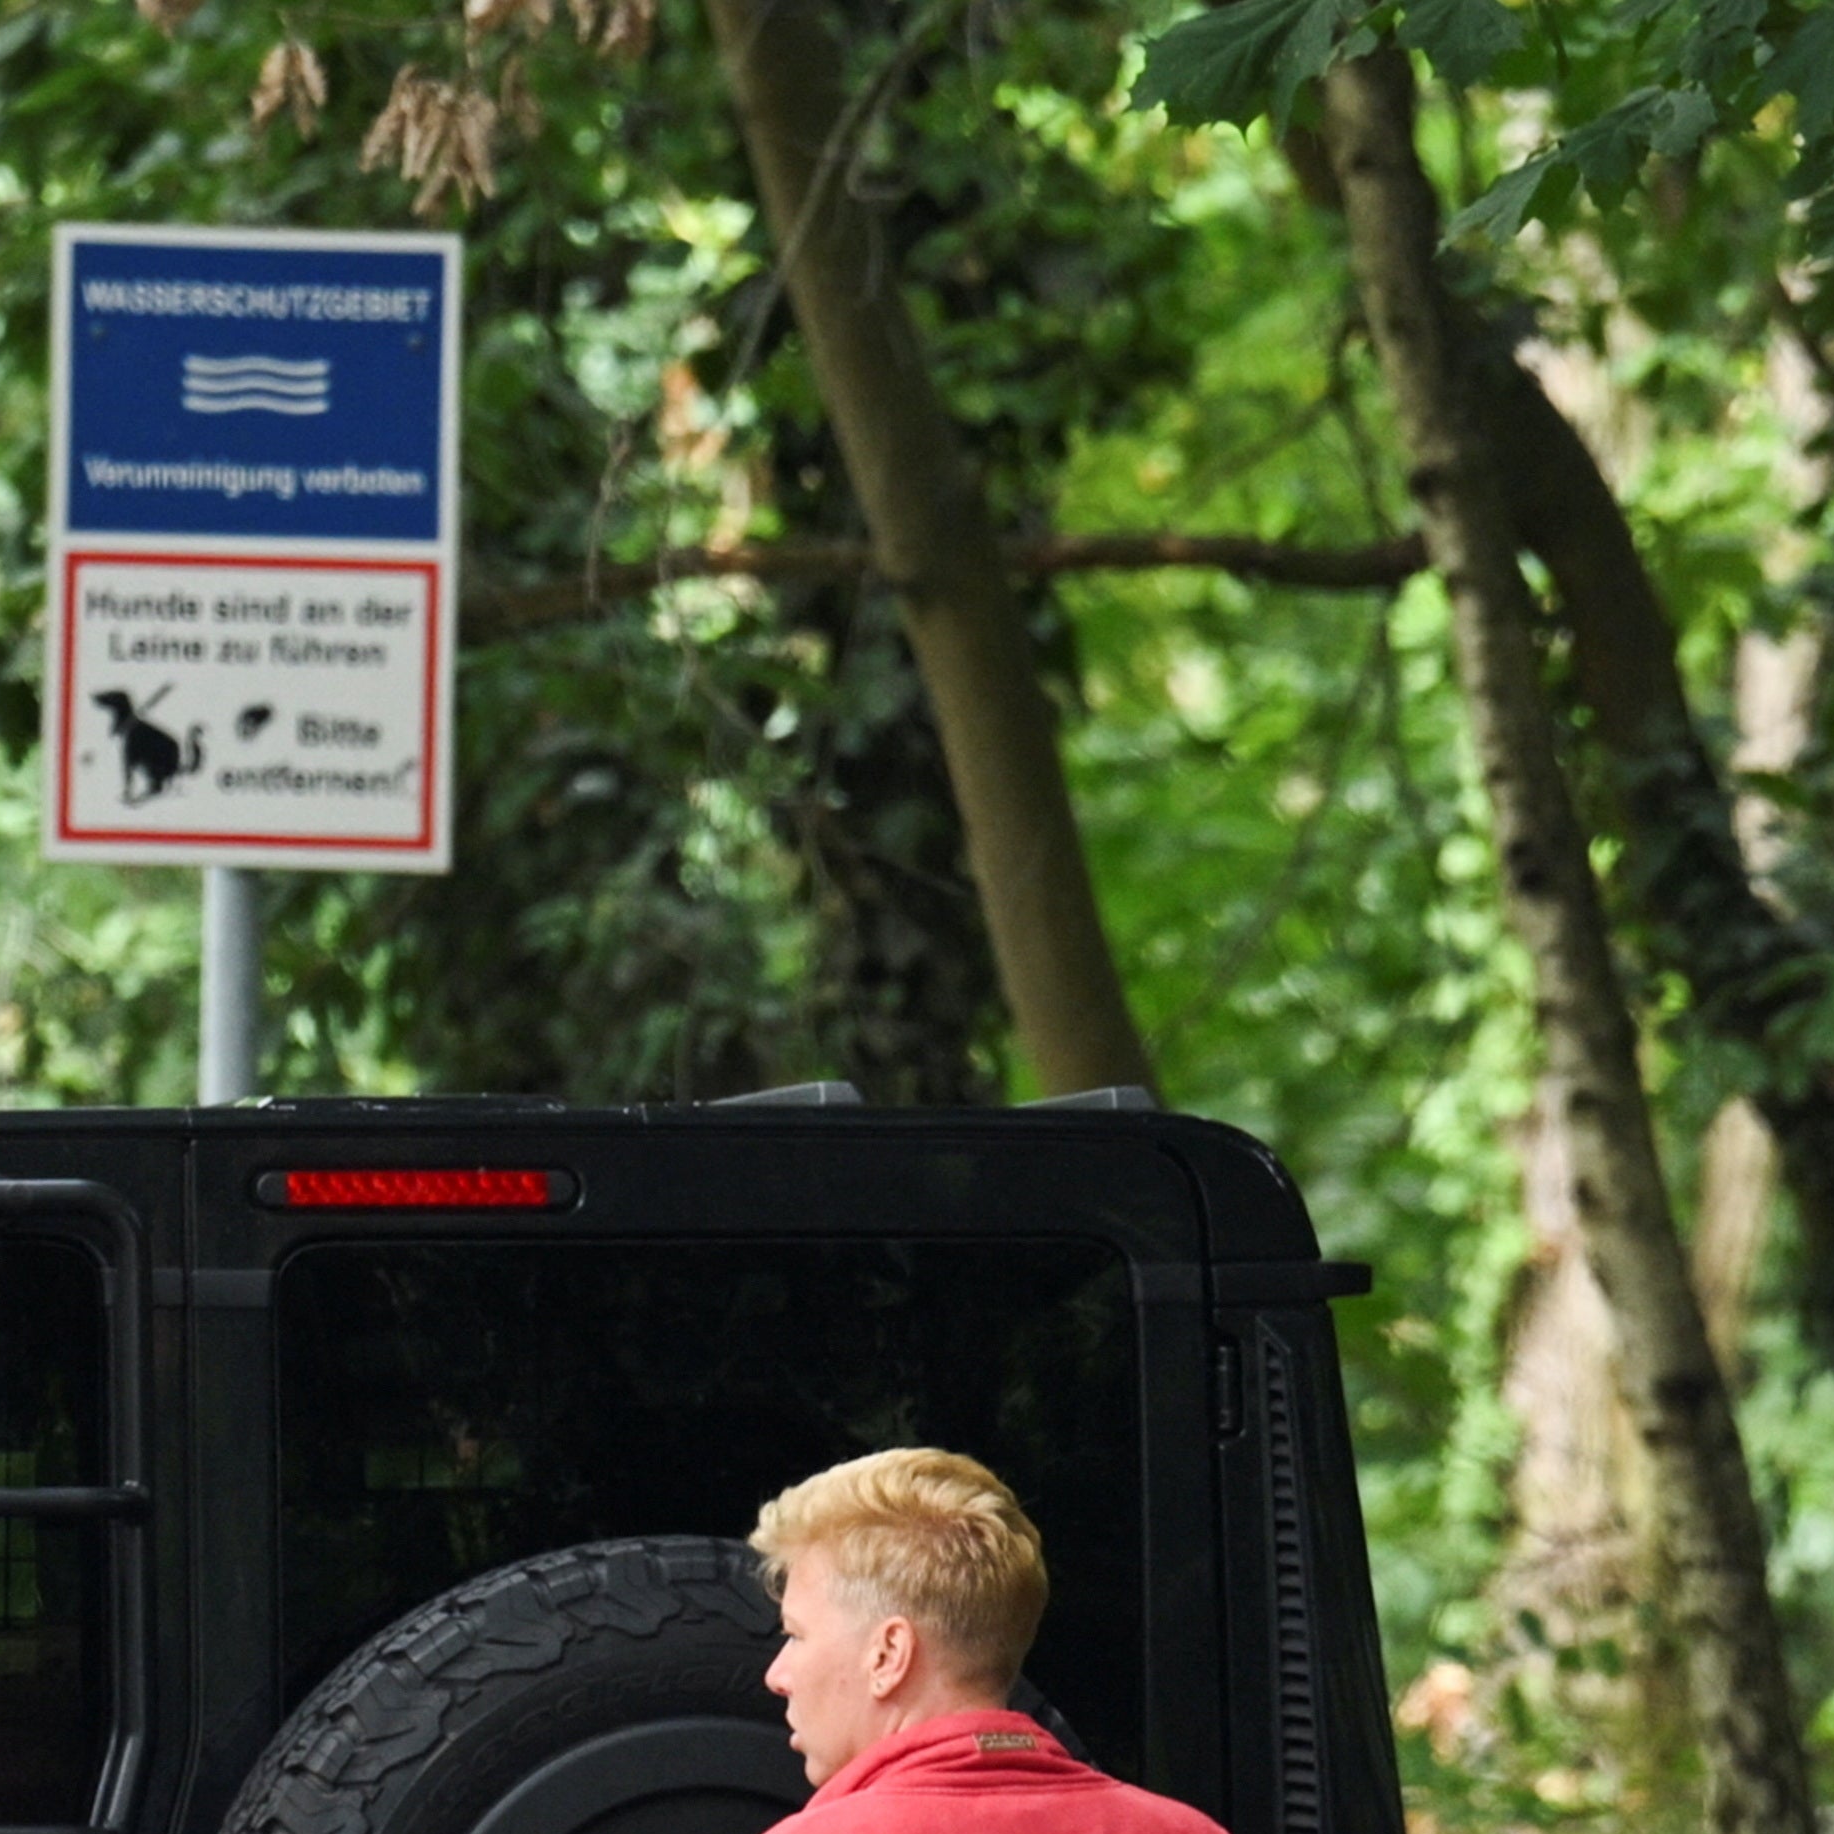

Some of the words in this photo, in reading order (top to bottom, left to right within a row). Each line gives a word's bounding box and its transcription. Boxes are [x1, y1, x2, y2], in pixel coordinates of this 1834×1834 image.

[82, 281, 430, 322] WASSERSCHUTZGEBIET
[83, 454, 297, 499] Verunreinigung
[302, 464, 426, 496] verboten
[85, 593, 200, 621] Hunde
[213, 595, 290, 623] sind
[302, 600, 342, 624] an
[356, 599, 413, 626] der
[109, 631, 203, 662] Leine
[215, 642, 260, 664] zu
[269, 635, 386, 665] führen
[297, 715, 381, 748] Bitte
